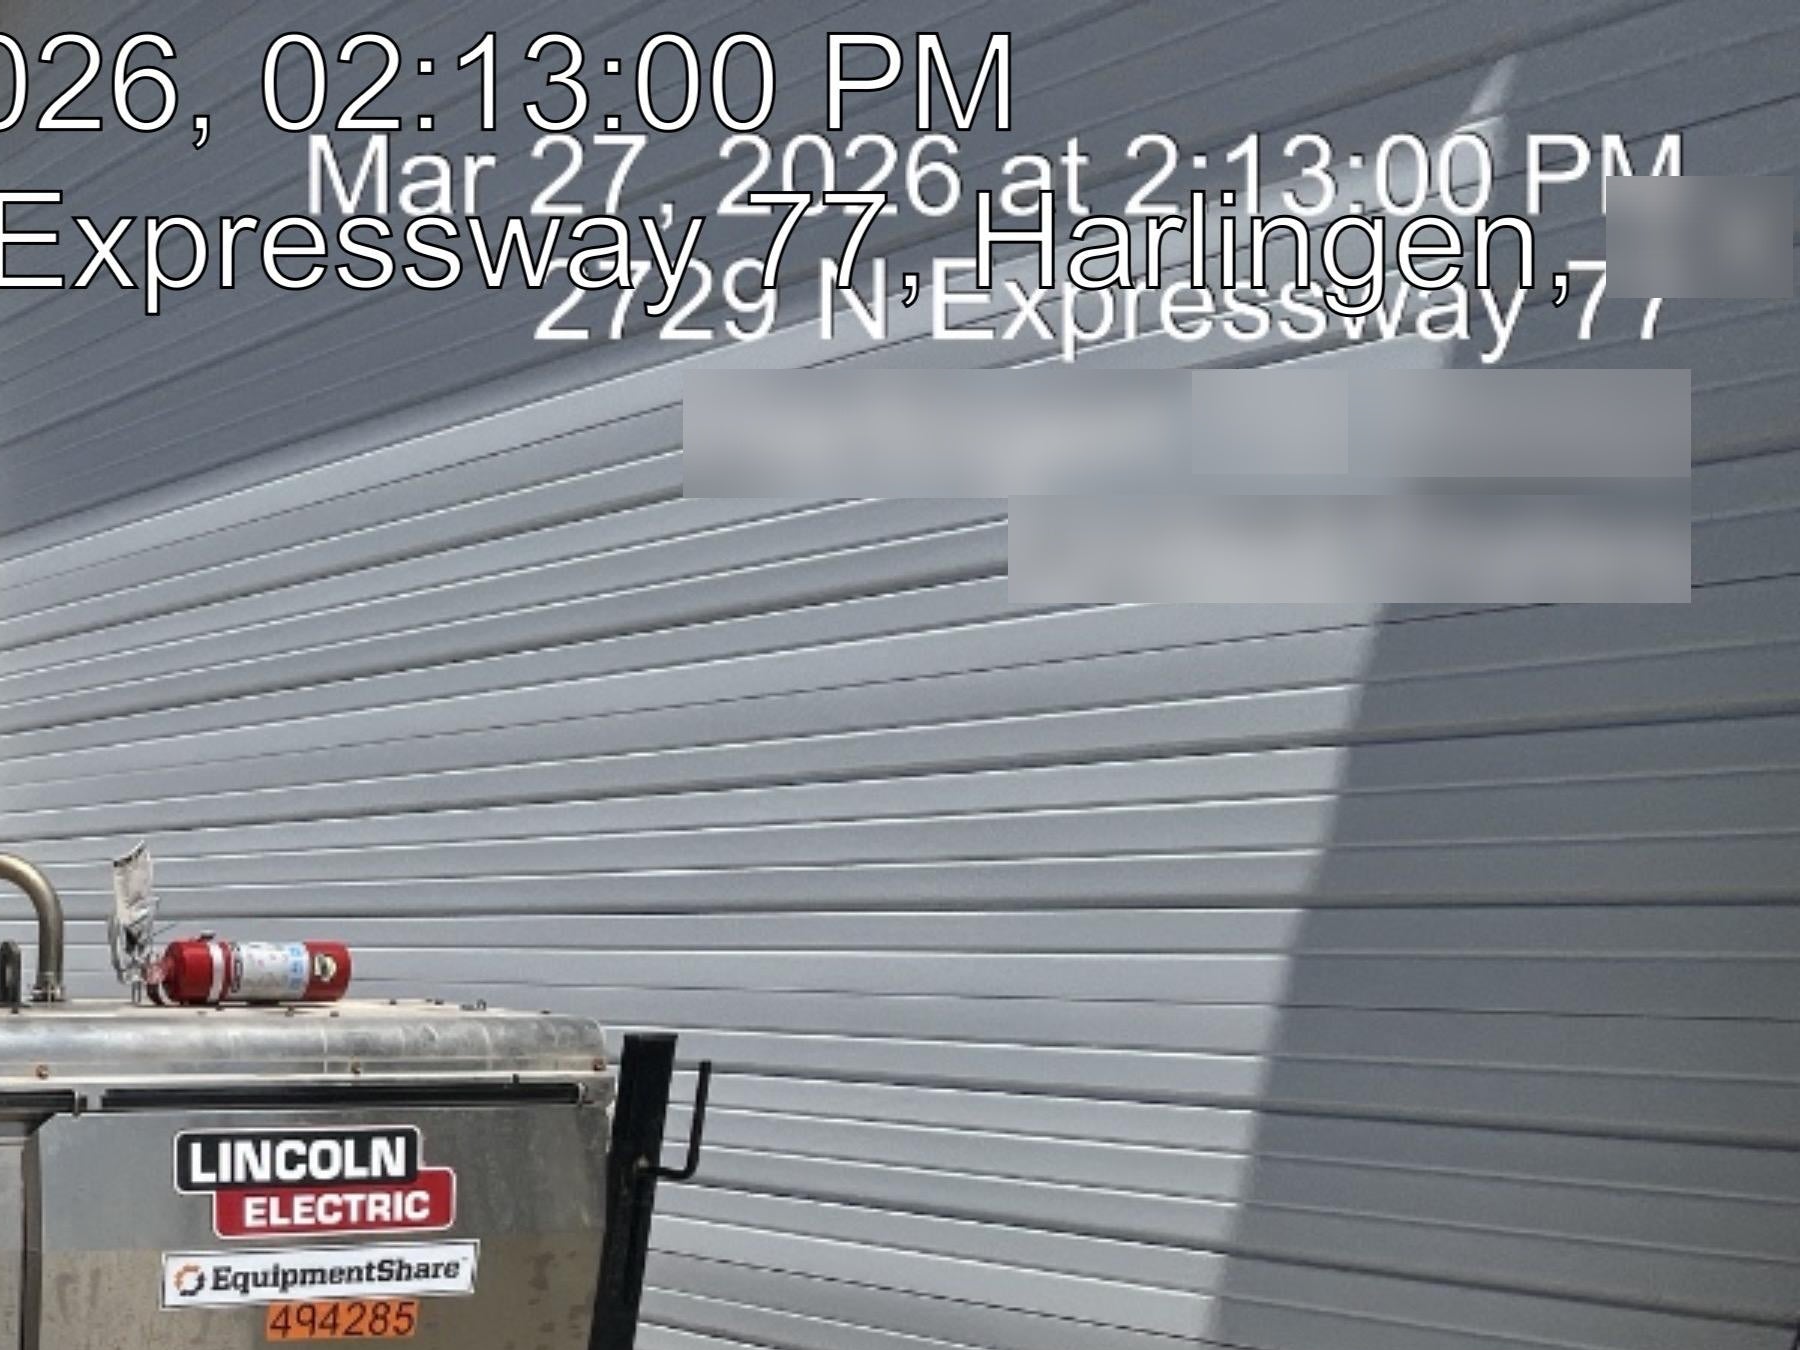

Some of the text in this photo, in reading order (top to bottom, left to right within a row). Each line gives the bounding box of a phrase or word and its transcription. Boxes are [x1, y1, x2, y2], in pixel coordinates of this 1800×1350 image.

[189, 1136, 407, 1184] LINCOLN
[242, 1190, 431, 1228] ELECTRIC
[210, 1259, 461, 1295] EquipmentShare
[269, 1300, 416, 1340] 494285
